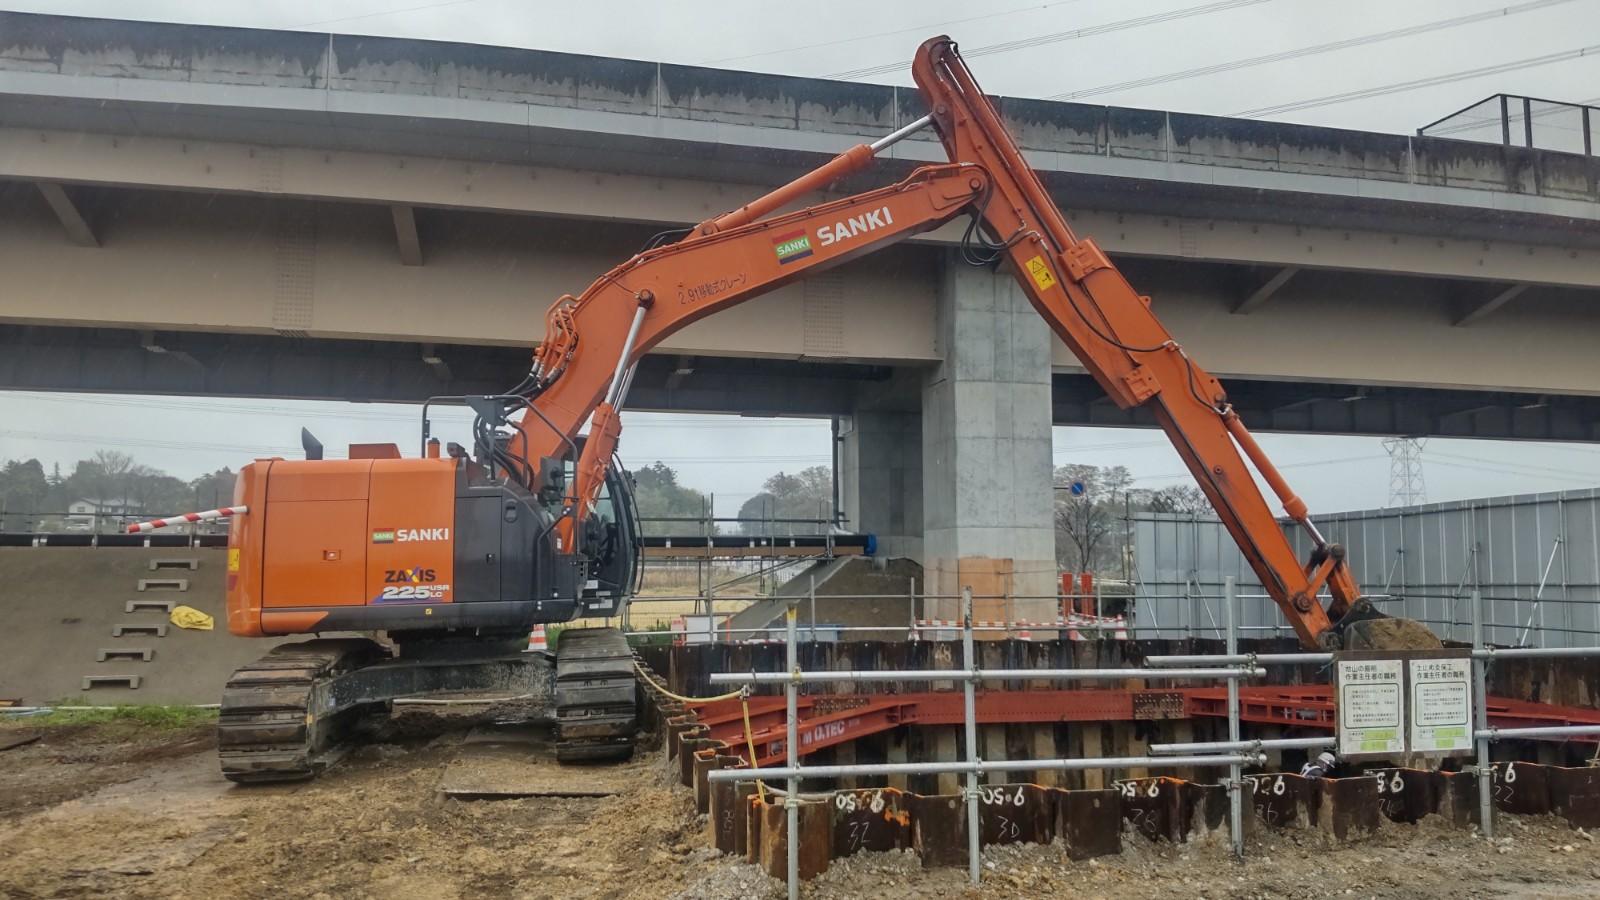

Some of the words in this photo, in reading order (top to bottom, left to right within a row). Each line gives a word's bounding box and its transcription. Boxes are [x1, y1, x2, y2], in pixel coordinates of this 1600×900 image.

[816, 206, 894, 247] SANKI
[776, 238, 810, 256] SANKI
[397, 528, 449, 542] SANKI
[385, 566, 436, 583] ZAXIS
[383, 586, 430, 600] 225
